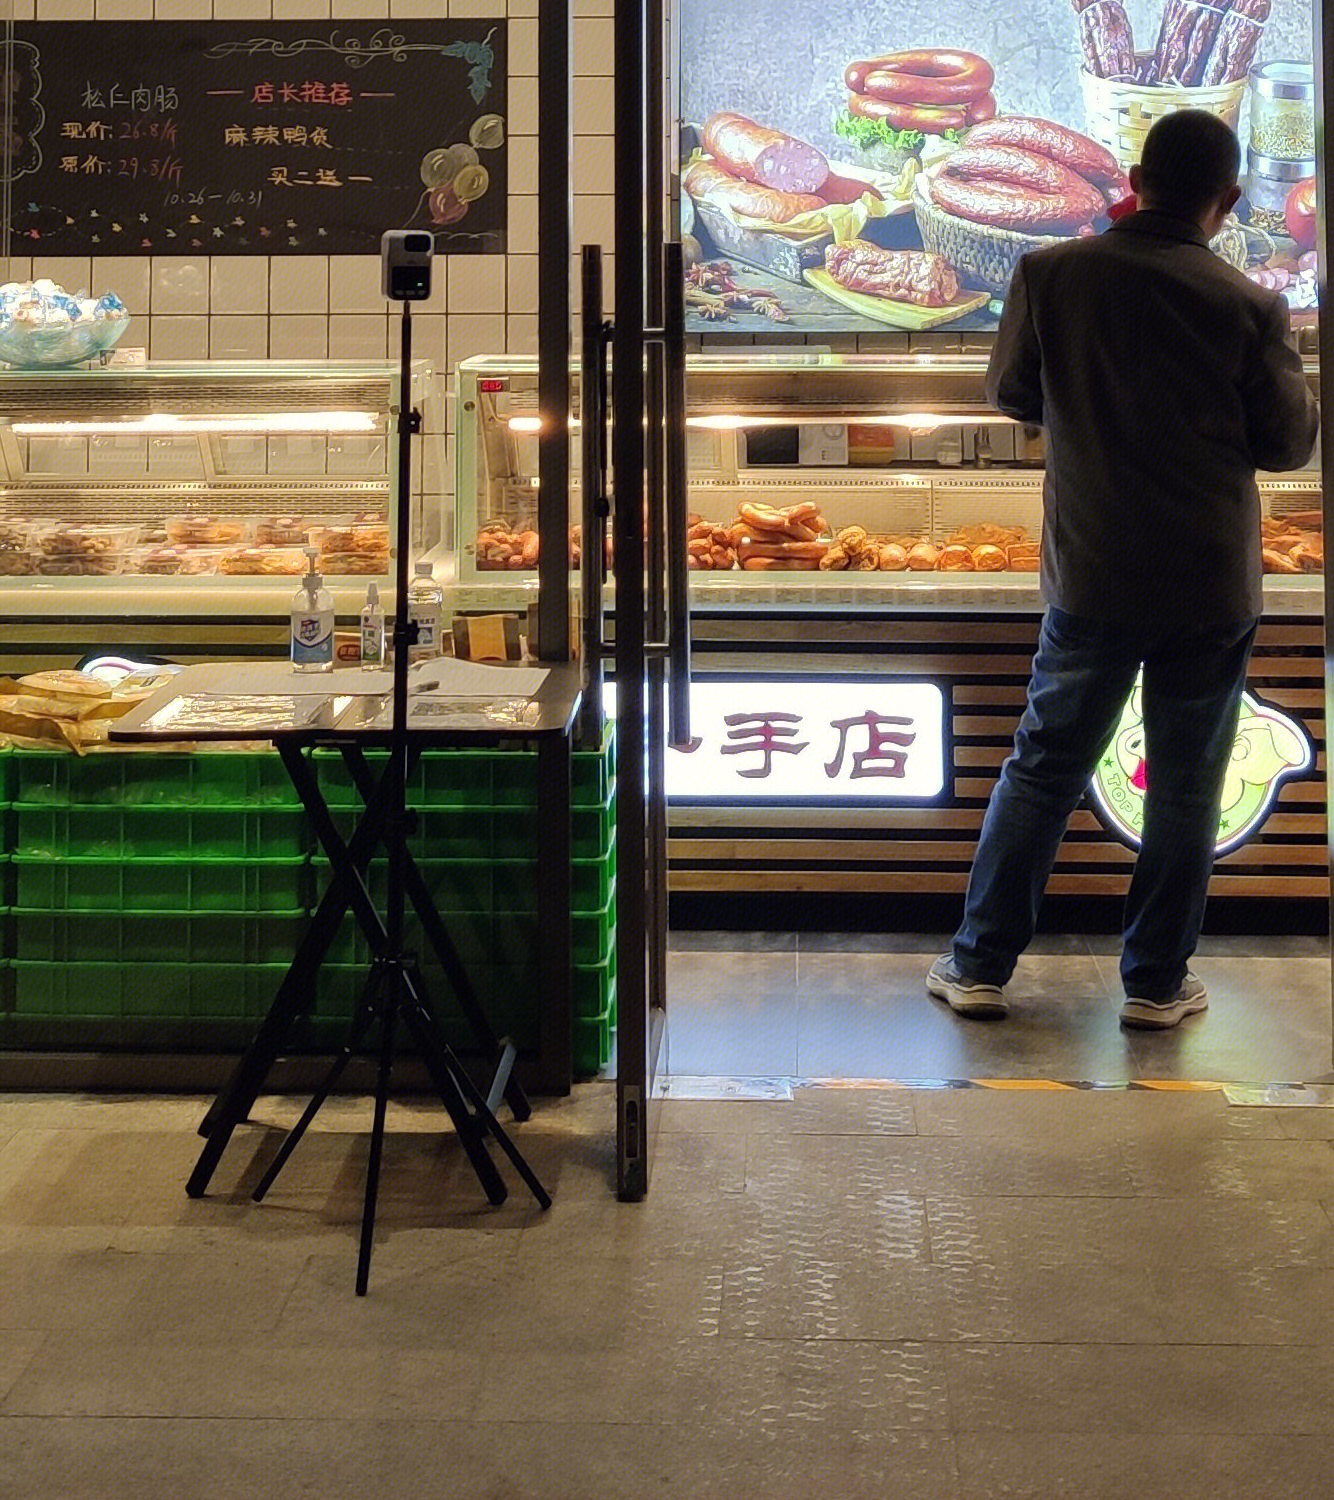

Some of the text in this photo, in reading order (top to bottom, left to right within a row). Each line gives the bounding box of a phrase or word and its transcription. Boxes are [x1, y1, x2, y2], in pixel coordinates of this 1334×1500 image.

[80, 80, 180, 113] 松仁肉肠
[250, 80, 354, 107] 店长推荐
[224, 124, 333, 149] 麻辣鸭货
[267, 166, 373, 187] 买二送一
